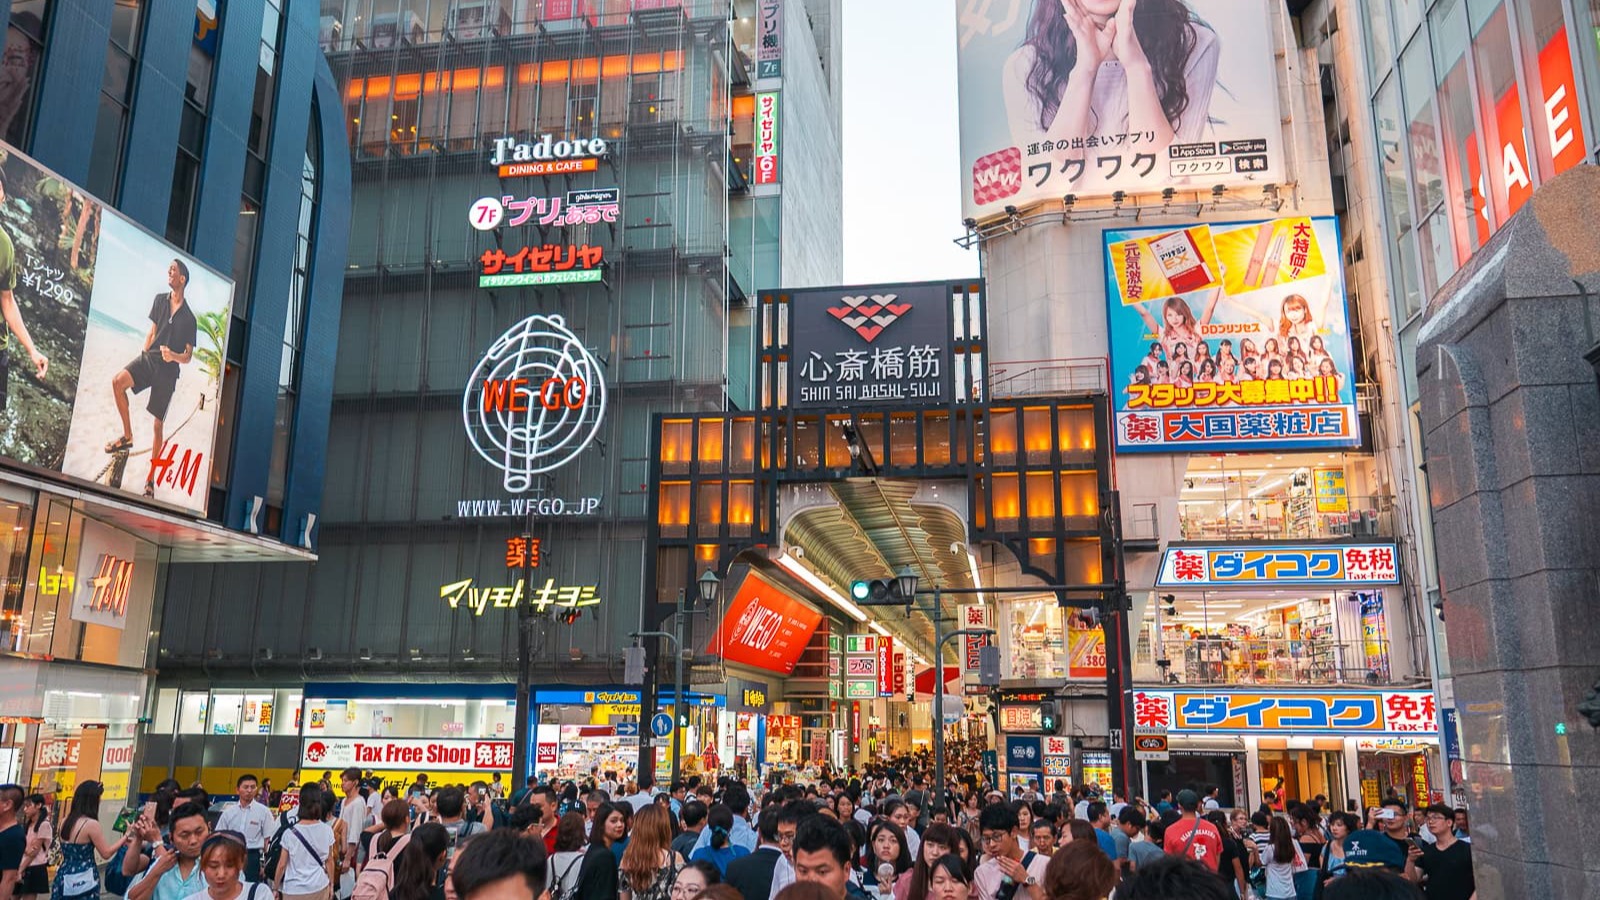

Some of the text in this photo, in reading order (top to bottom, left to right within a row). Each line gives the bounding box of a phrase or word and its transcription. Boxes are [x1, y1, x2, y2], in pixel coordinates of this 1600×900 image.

[763, 62, 777, 72] 7F
[760, 96, 774, 155] サイゼリヤ
[490, 134, 608, 165] J'adore
[1027, 131, 1156, 157] 運命の出会いアプリ
[1478, 84, 1575, 221] AE
[509, 161, 583, 175] DINING & CAFE
[760, 155, 774, 183] 6F
[1027, 152, 1157, 188] ワクワク
[1176, 161, 1225, 172] ワクワク
[477, 206, 497, 224] 7F
[25, 253, 65, 281] Tシャツ
[480, 244, 603, 275] サイゼリヤ
[1123, 242, 1143, 299] 元気激安
[1162, 253, 1189, 270] EX
[22, 268, 73, 305] ¥1,299
[1201, 322, 1261, 335] DDプリンセス
[799, 344, 941, 382] 心斎橋筋
[801, 386, 831, 402] SHIN
[835, 384, 857, 401] SAI
[1127, 375, 1340, 408] スタッフ大募集中!!
[1126, 413, 1159, 441] 薬
[1170, 410, 1342, 438] 大国薬粧店
[150, 439, 203, 497] H&M
[505, 537, 541, 568] 薬
[1173, 548, 1394, 581] 薬 ダイコク 免税
[92, 553, 135, 616] H&M
[1346, 571, 1396, 580] Tax-Free
[440, 578, 602, 616] マツモトキヨシ
[740, 606, 784, 651] WEGO
[967, 606, 984, 625] 薬
[1085, 656, 1106, 667] 380
[766, 716, 800, 728] SALE
[1135, 692, 1169, 727] 薬
[1182, 696, 1375, 727] ダイコク
[354, 742, 471, 765] Tax Free Shop
[476, 744, 513, 766] 免税
[1048, 736, 1066, 754] 薬
